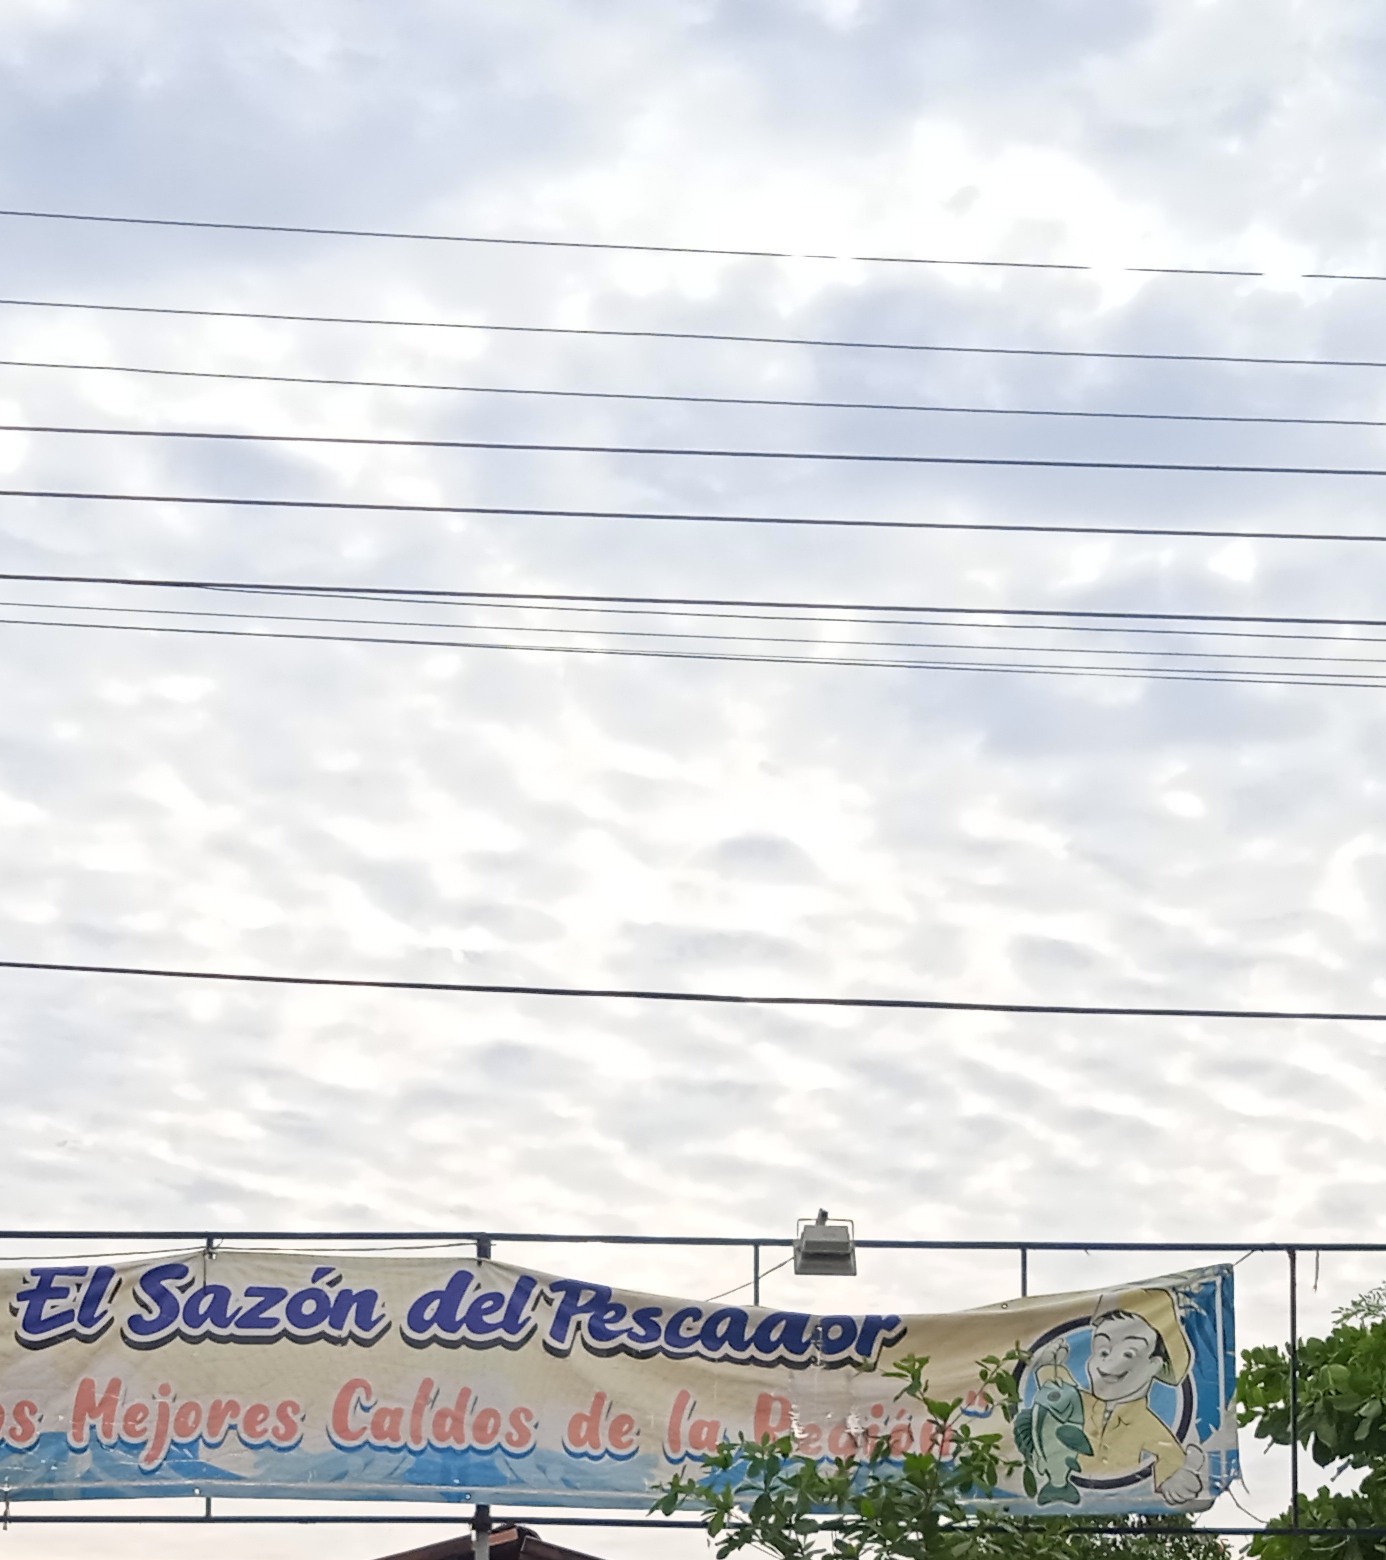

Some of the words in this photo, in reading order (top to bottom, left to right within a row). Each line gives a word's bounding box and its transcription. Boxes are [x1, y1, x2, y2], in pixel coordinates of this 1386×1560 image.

[15, 1264, 117, 1336] El
[146, 1262, 388, 1337] Sazón
[406, 1268, 534, 1336] del
[71, 1376, 302, 1466] Mejores
[331, 1377, 534, 1447] Caldos
[567, 1390, 636, 1451] de
[667, 1388, 721, 1454] la
